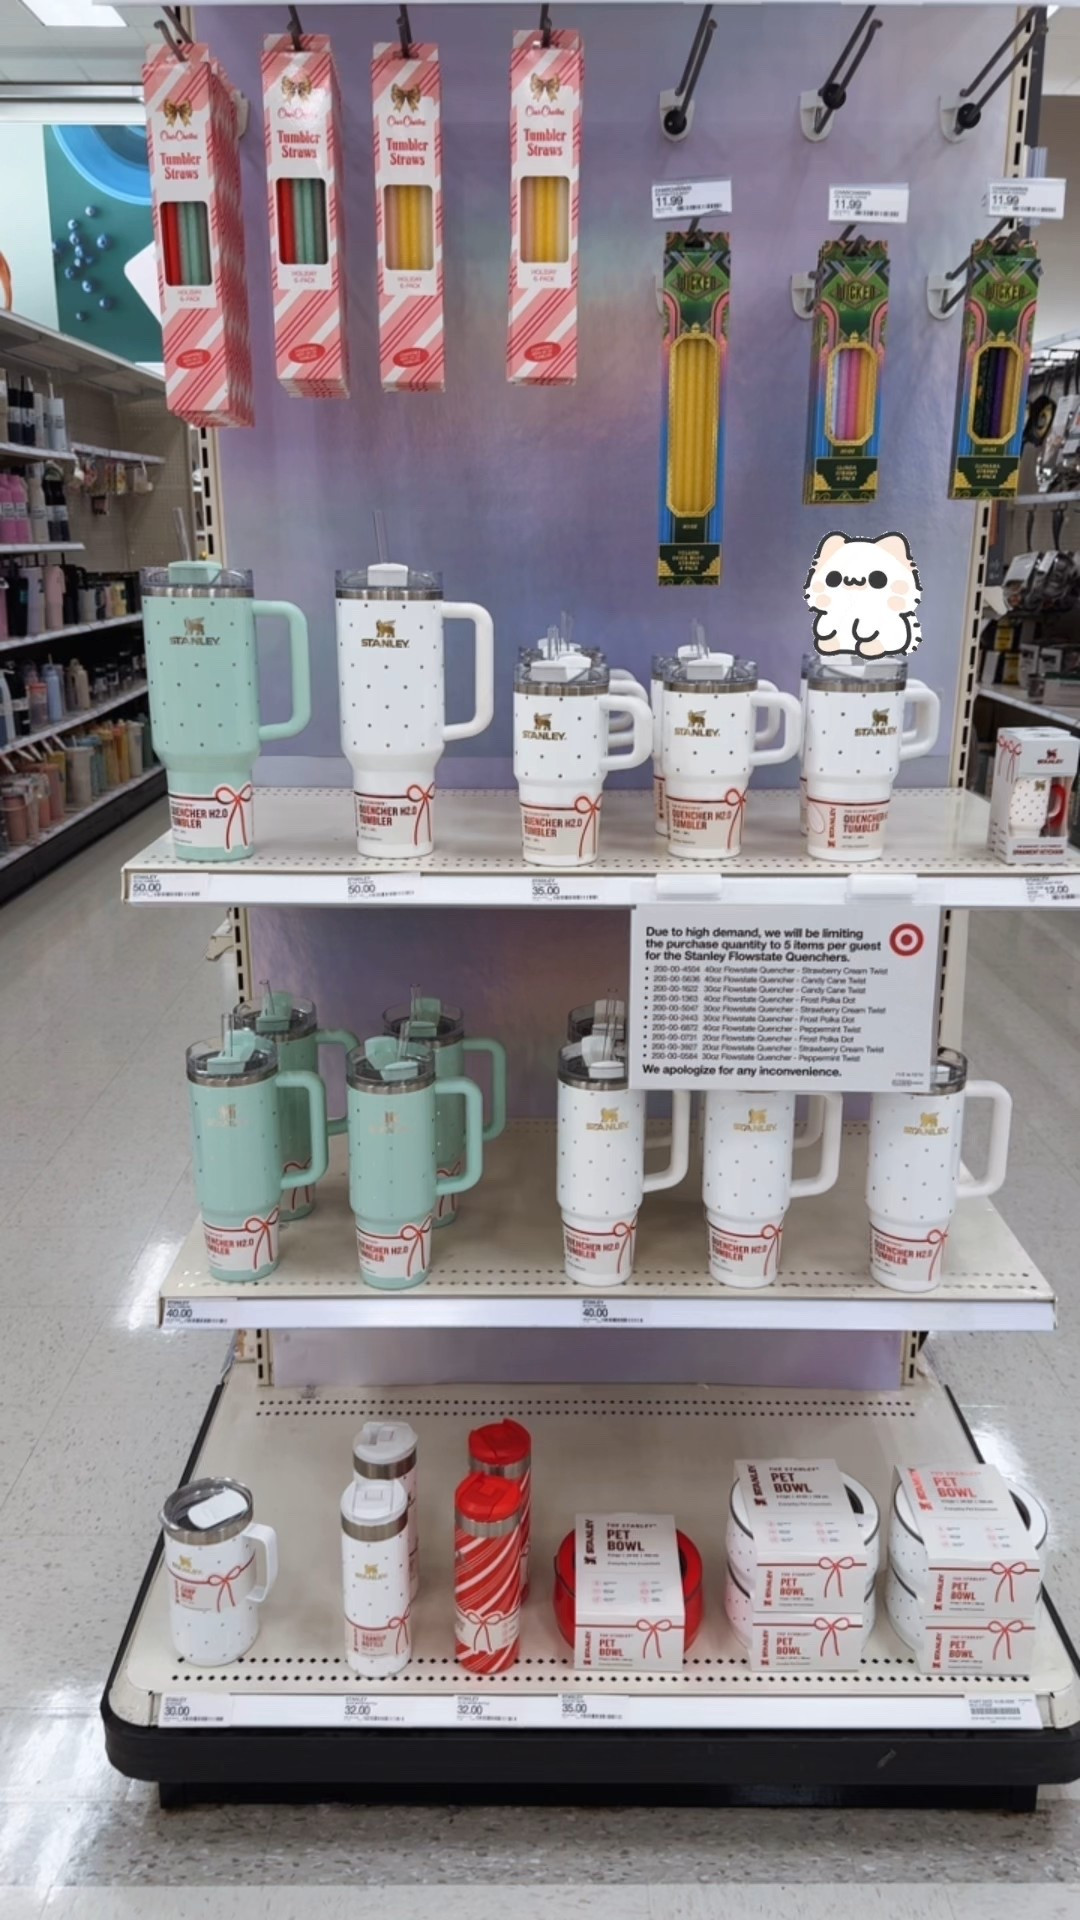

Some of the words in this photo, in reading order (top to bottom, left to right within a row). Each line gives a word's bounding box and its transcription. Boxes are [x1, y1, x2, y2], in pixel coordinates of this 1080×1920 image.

[277, 130, 321, 143] Tumbler
[523, 128, 567, 142] Tumbler
[386, 138, 429, 151] Tumbler
[527, 143, 563, 156] Straws
[281, 145, 317, 158] Straws
[160, 152, 201, 165] Tumbler
[390, 153, 425, 165] Straws
[164, 167, 199, 180] Straws
[656, 196, 683, 207] 11.99
[835, 199, 862, 210] 11.99
[993, 195, 1019, 206] 11.99
[169, 637, 221, 646] STANLEY
[361, 638, 410, 648] STANLEY
[522, 730, 567, 740] STANLEY
[674, 727, 721, 737] STANLEY
[854, 727, 898, 737] STANLEY
[843, 822, 880, 833] TUMBLER
[133, 882, 161, 892] 50.00
[347, 884, 376, 894] 50.00
[532, 886, 560, 896] 35.00
[646, 927, 669, 937] Due
[672, 927, 683, 937] to
[685, 927, 710, 939] high
[712, 927, 761, 938] demand,
[764, 930, 781, 938] we
[784, 928, 803, 938] will
[805, 928, 820, 938] be
[822, 928, 864, 940] limiting
[646, 939, 663, 948] the
[666, 940, 719, 950] purchase
[721, 940, 767, 951] quantity
[770, 941, 781, 949] to
[784, 940, 791, 949] 5
[793, 941, 824, 950] items
[827, 943, 846, 952] per
[849, 942, 881, 952] guest
[645, 951, 660, 960] for
[664, 951, 681, 960] the
[684, 951, 726, 963] Stanley
[728, 951, 783, 962] Flowstate
[785, 952, 850, 962] Quenchers.
[759, 966, 795, 974] Quencher
[801, 967, 841, 976] Strawberry
[843, 967, 867, 975] Cream
[759, 976, 794, 984] Quencher
[801, 977, 825, 985] Candy
[723, 985, 757, 993] Flowstate
[758, 986, 794, 994] Quencher
[800, 987, 825, 995] Candy
[723, 995, 757, 1003] Flowstate
[758, 995, 794, 1004] Quencher
[820, 996, 841, 1004] Polka
[722, 1005, 756, 1013] Flowstate
[758, 1006, 793, 1014] Quencher
[800, 1006, 839, 1015] Strawberry
[841, 1006, 866, 1014] Cream
[757, 1015, 793, 1023] Quencher
[757, 1025, 793, 1033] Quencher
[799, 1026, 841, 1034] Peppermint
[721, 1034, 755, 1042] Flowstate
[757, 1035, 792, 1043] Quencher
[819, 1035, 839, 1043] Polka
[757, 1044, 792, 1052] Quencher
[799, 1045, 838, 1054] Strawberry
[839, 1045, 864, 1053] Cream
[721, 1053, 755, 1061] Flowstate
[757, 1054, 792, 1062] Quencher
[799, 1054, 841, 1063] Peppermint
[642, 1064, 660, 1074] We
[662, 1065, 716, 1077] apologize
[719, 1065, 734, 1075] for
[736, 1067, 756, 1077] any
[759, 1066, 842, 1077] inconvenience.
[166, 1308, 193, 1318] 40.00
[582, 1308, 608, 1317] 40.00
[770, 1472, 794, 1482] PET
[932, 1477, 957, 1487] PET
[773, 1483, 813, 1493] BOWL
[937, 1487, 977, 1498] BOWL
[607, 1529, 631, 1540] PET
[607, 1540, 645, 1552] BOWL
[780, 1578, 798, 1587] PET
[952, 1582, 968, 1591] PET
[780, 1588, 805, 1596] BOWL
[951, 1591, 976, 1600] BOWL
[600, 1639, 616, 1647] PET
[777, 1637, 793, 1646] PET
[950, 1640, 966, 1649] PET
[599, 1648, 624, 1657] BOWL
[776, 1647, 801, 1656] BOWL
[949, 1650, 974, 1658] BOWL
[164, 1706, 190, 1716] 30.00
[344, 1705, 371, 1715] 32.00
[457, 1704, 483, 1715] 32.00
[562, 1703, 588, 1713] 35.00
